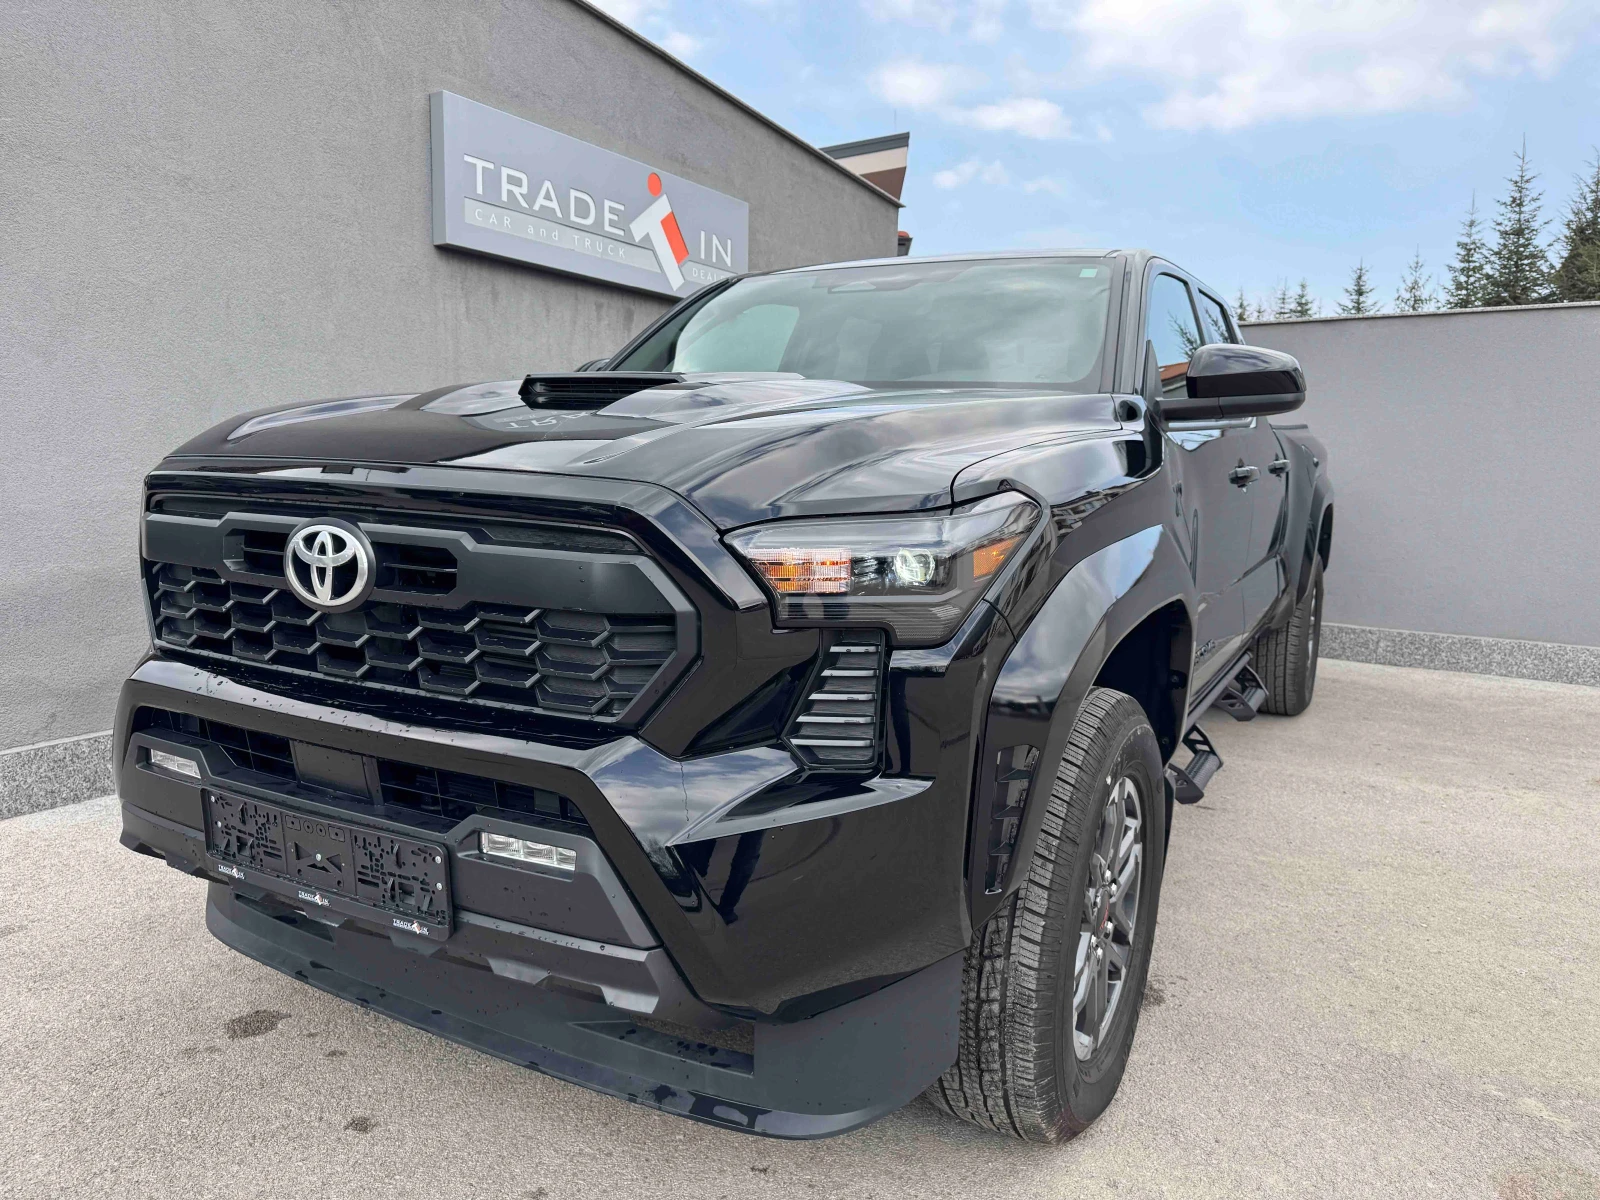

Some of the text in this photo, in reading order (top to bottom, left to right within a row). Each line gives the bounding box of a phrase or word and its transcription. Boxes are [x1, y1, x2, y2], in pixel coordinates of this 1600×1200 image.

[463, 154, 732, 267] TRADE IN
[475, 208, 511, 229] CAR
[527, 225, 559, 241] and
[573, 234, 626, 258] TRUCK
